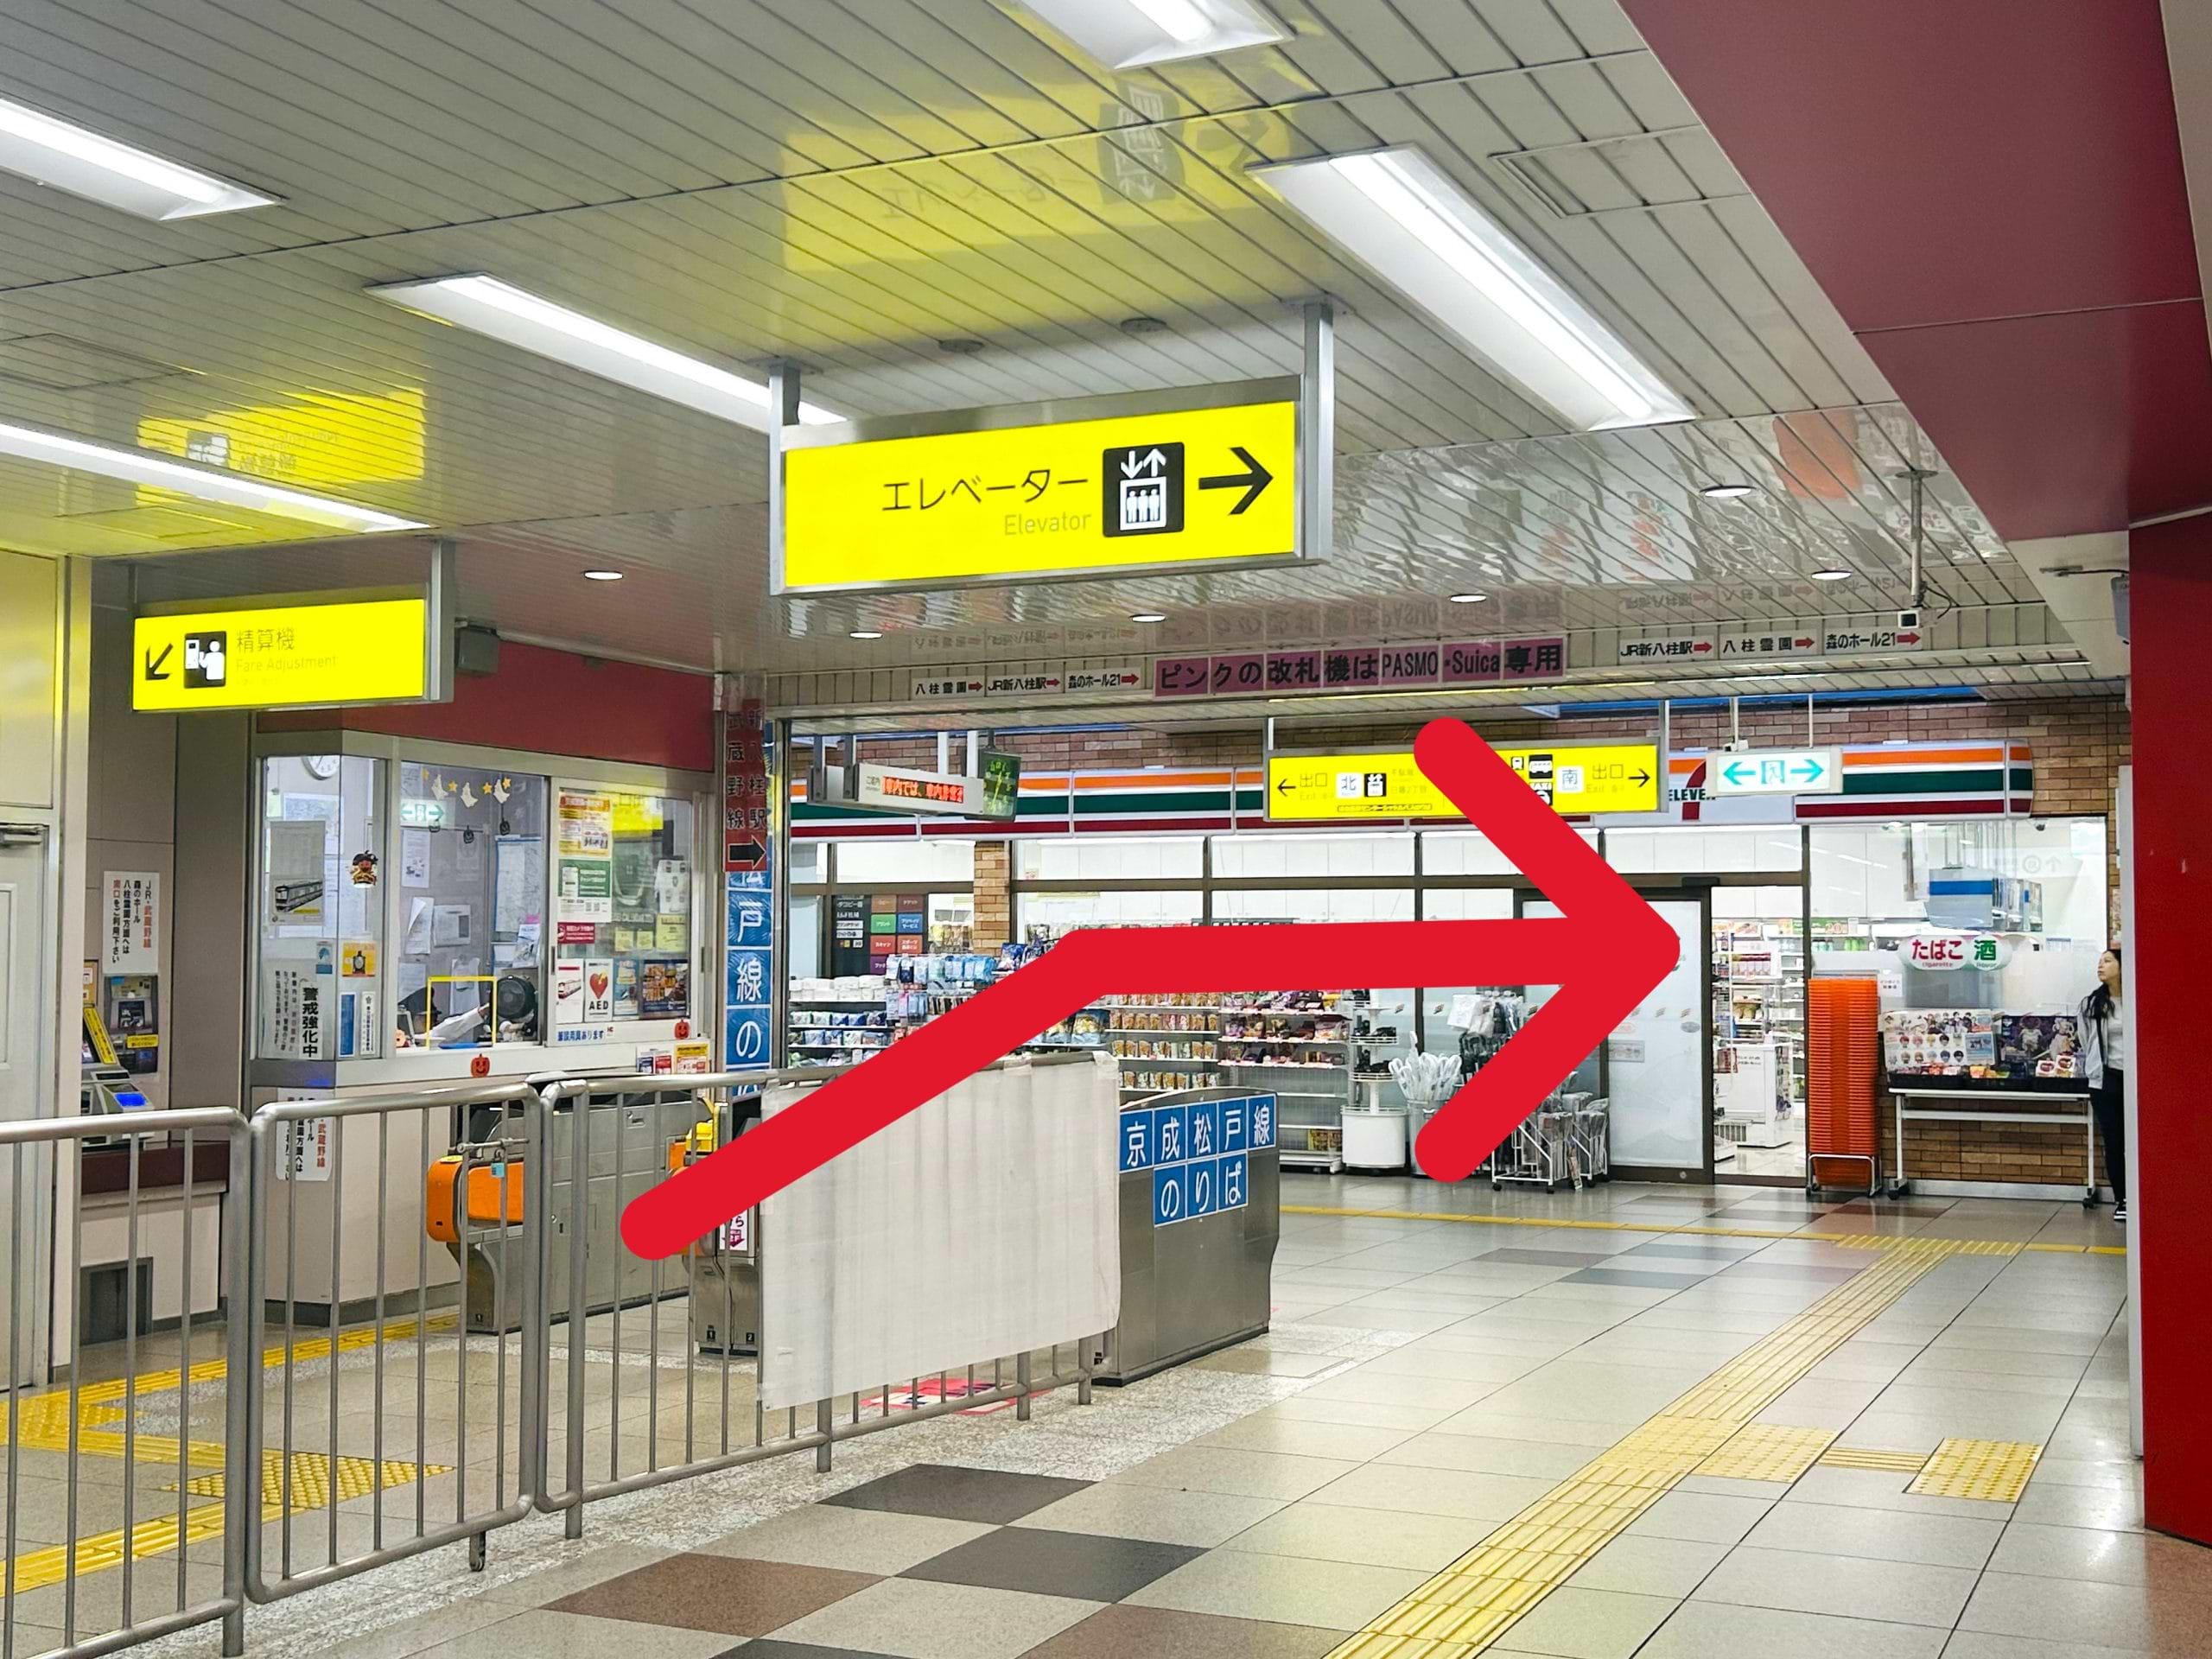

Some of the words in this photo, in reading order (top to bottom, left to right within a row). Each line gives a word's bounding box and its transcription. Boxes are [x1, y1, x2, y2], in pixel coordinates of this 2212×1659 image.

[882, 469, 1089, 511] エレベーター
[1004, 512, 1092, 535] Elevator
[235, 626, 295, 653] 精算機
[1620, 641, 1693, 657] JR新八柱駅
[1723, 637, 1793, 653] 八柱霊園
[1826, 632, 1897, 649] 森のホール21
[235, 658, 264, 672] Fare
[266, 653, 338, 673] Adjustment
[988, 677, 1046, 691] JR新八柱駅
[726, 710, 746, 830] 武蔵野線
[747, 707, 767, 831] 新八柱駅
[1300, 772, 1328, 787] 出口
[1561, 769, 1580, 785] 南
[1592, 763, 1624, 779] 出口
[1340, 774, 1357, 791] 北
[1912, 938, 1964, 961] たばこ
[1974, 939, 1997, 961] 酒
[588, 1001, 609, 1010] AED
[302, 987, 320, 1058] 警戒強化中
[1126, 1103, 1270, 1167] 京成松戸線
[1160, 1160, 1243, 1217] のりば
